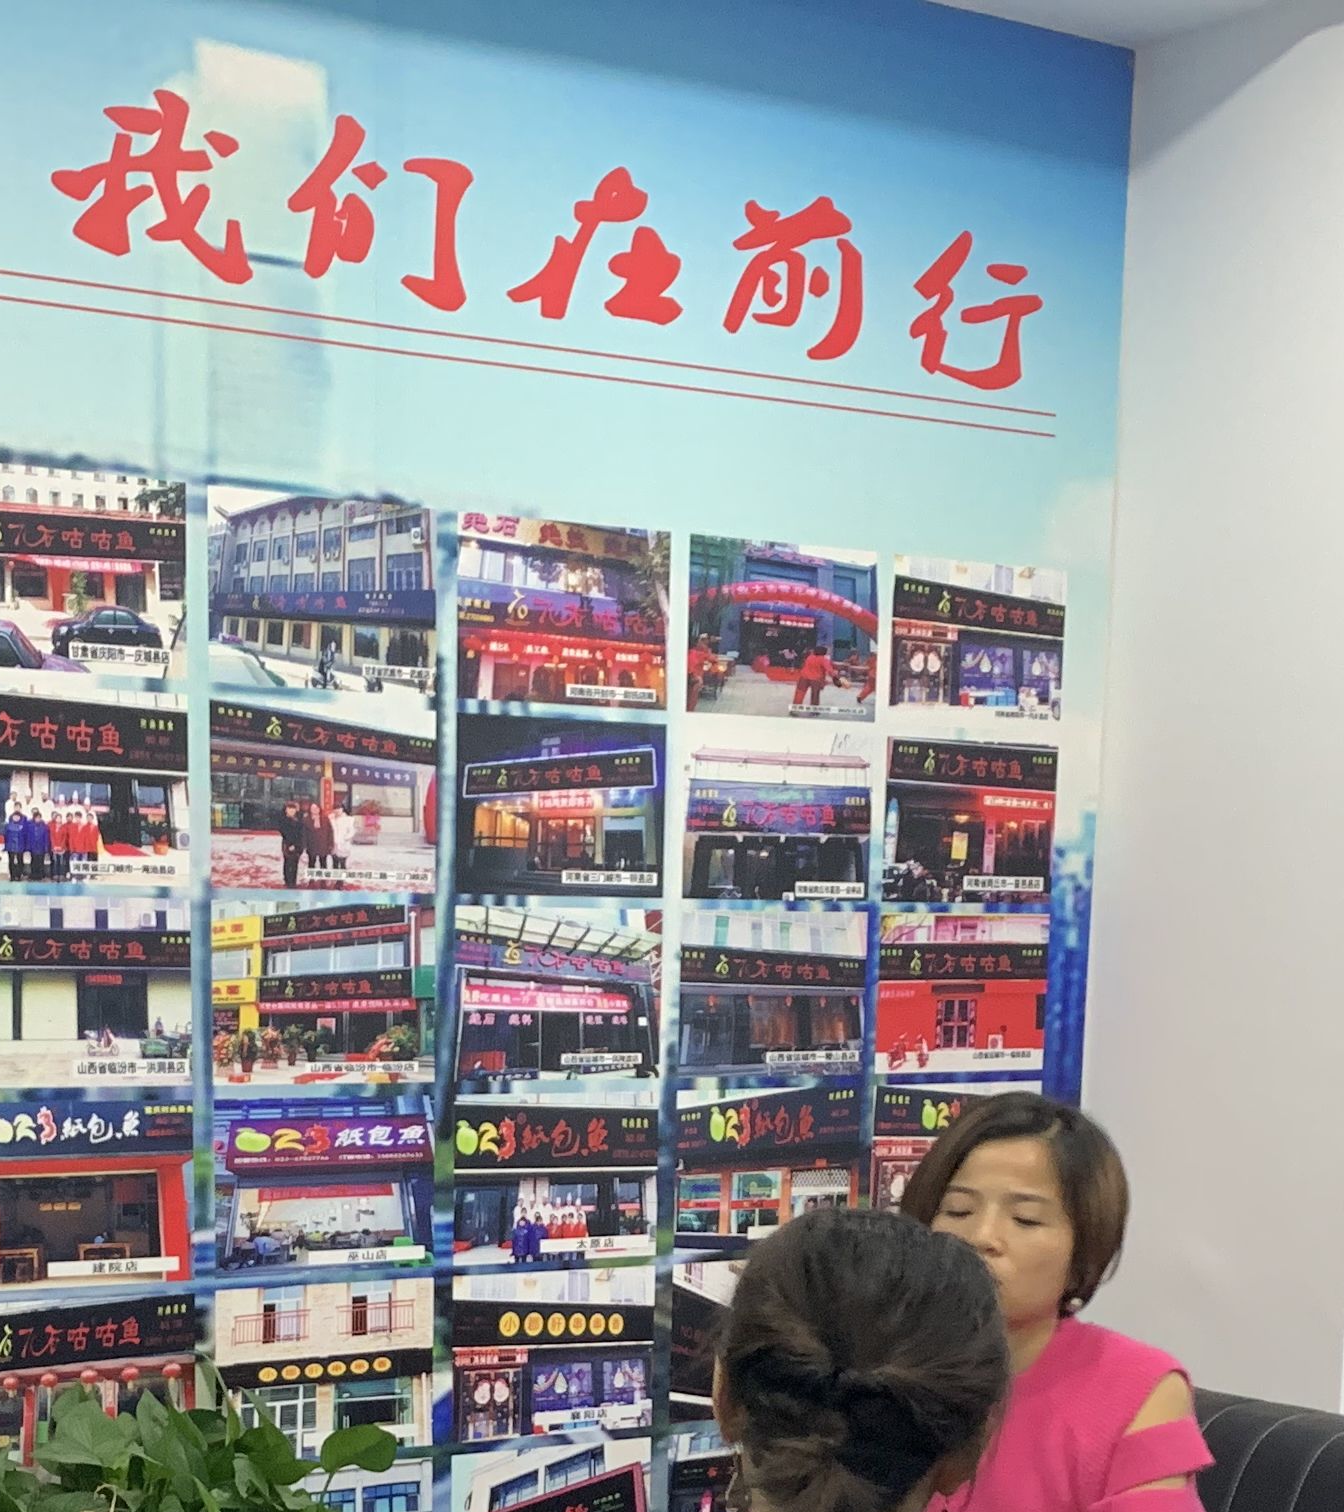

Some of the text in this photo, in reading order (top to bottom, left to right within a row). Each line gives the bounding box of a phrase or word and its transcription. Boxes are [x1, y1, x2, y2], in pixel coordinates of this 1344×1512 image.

[51, 89, 1044, 392] 我们在前行
